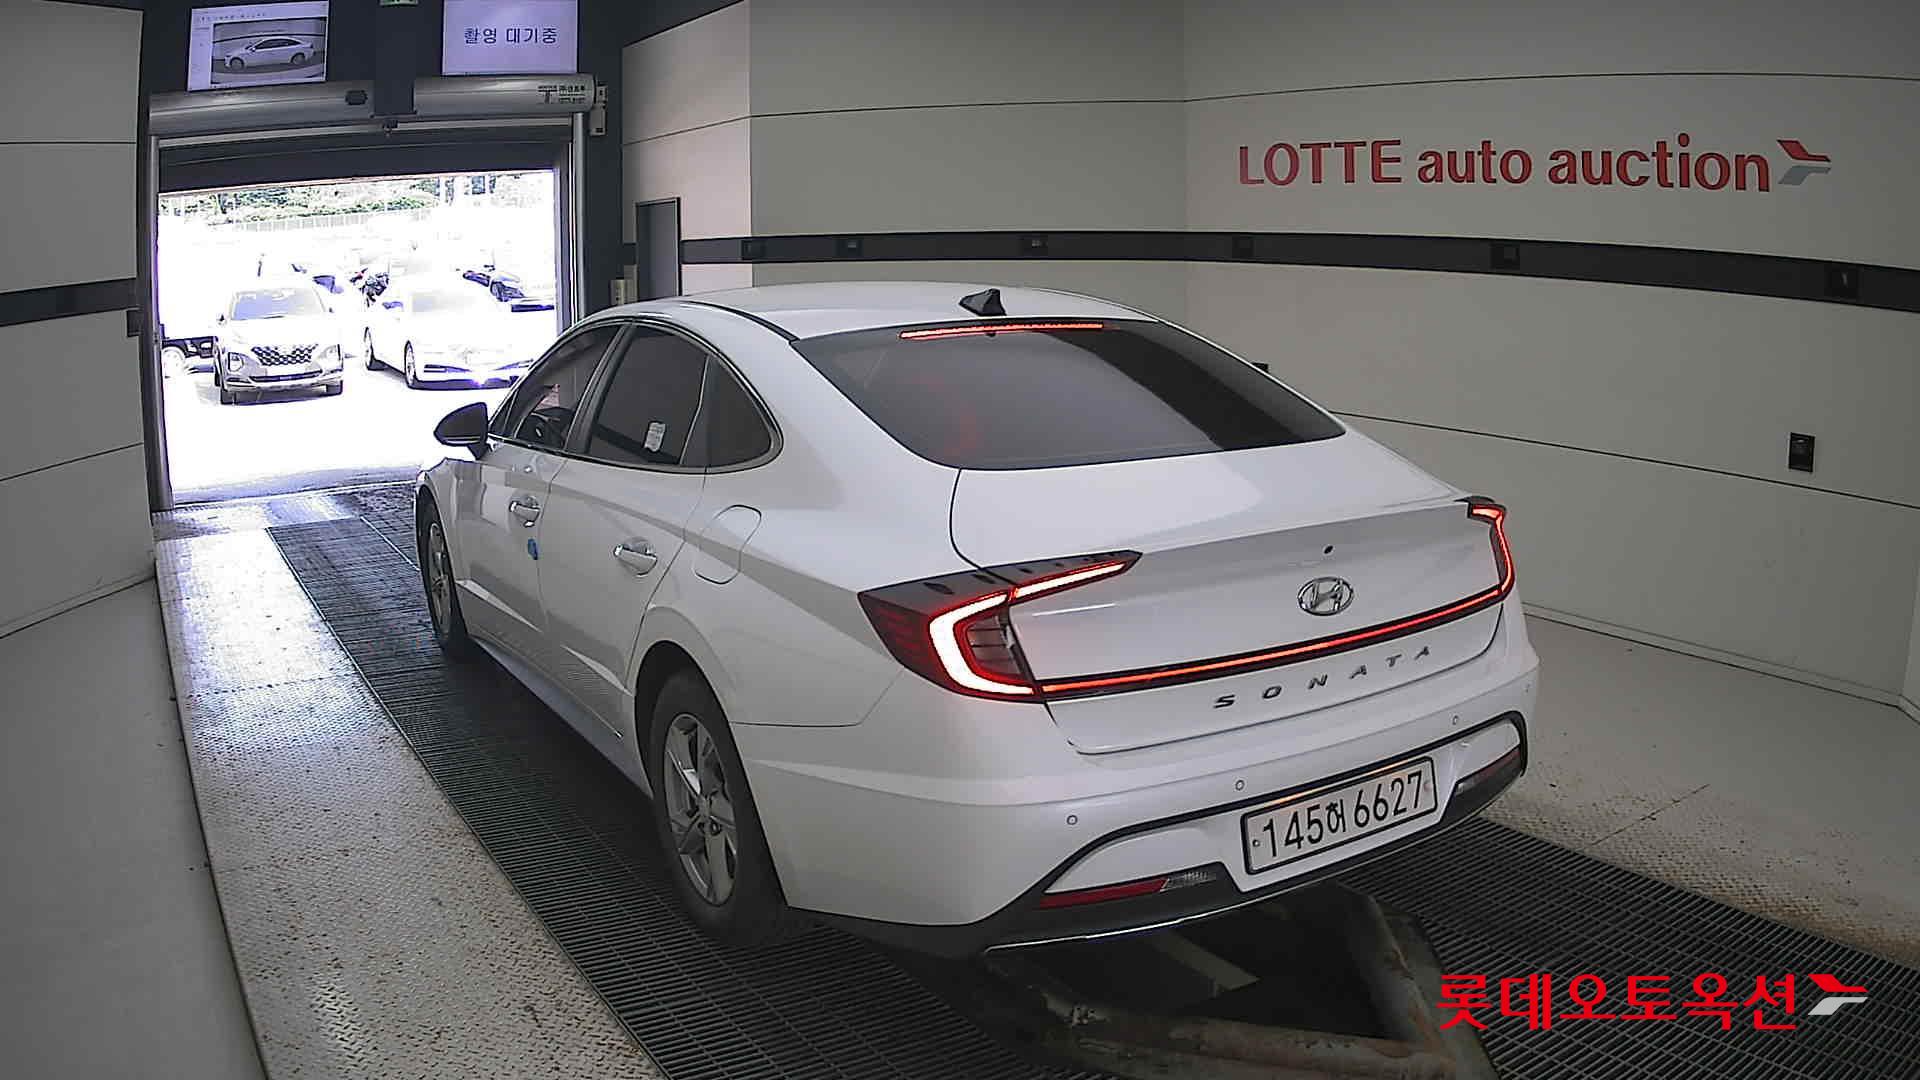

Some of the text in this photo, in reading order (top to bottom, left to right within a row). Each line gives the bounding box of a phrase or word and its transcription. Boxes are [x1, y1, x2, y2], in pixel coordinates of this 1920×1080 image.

[464, 27, 558, 45] 촬영 대기중
[1239, 132, 1771, 193] LOTTE auto auction
[1213, 646, 1430, 709] SONATA
